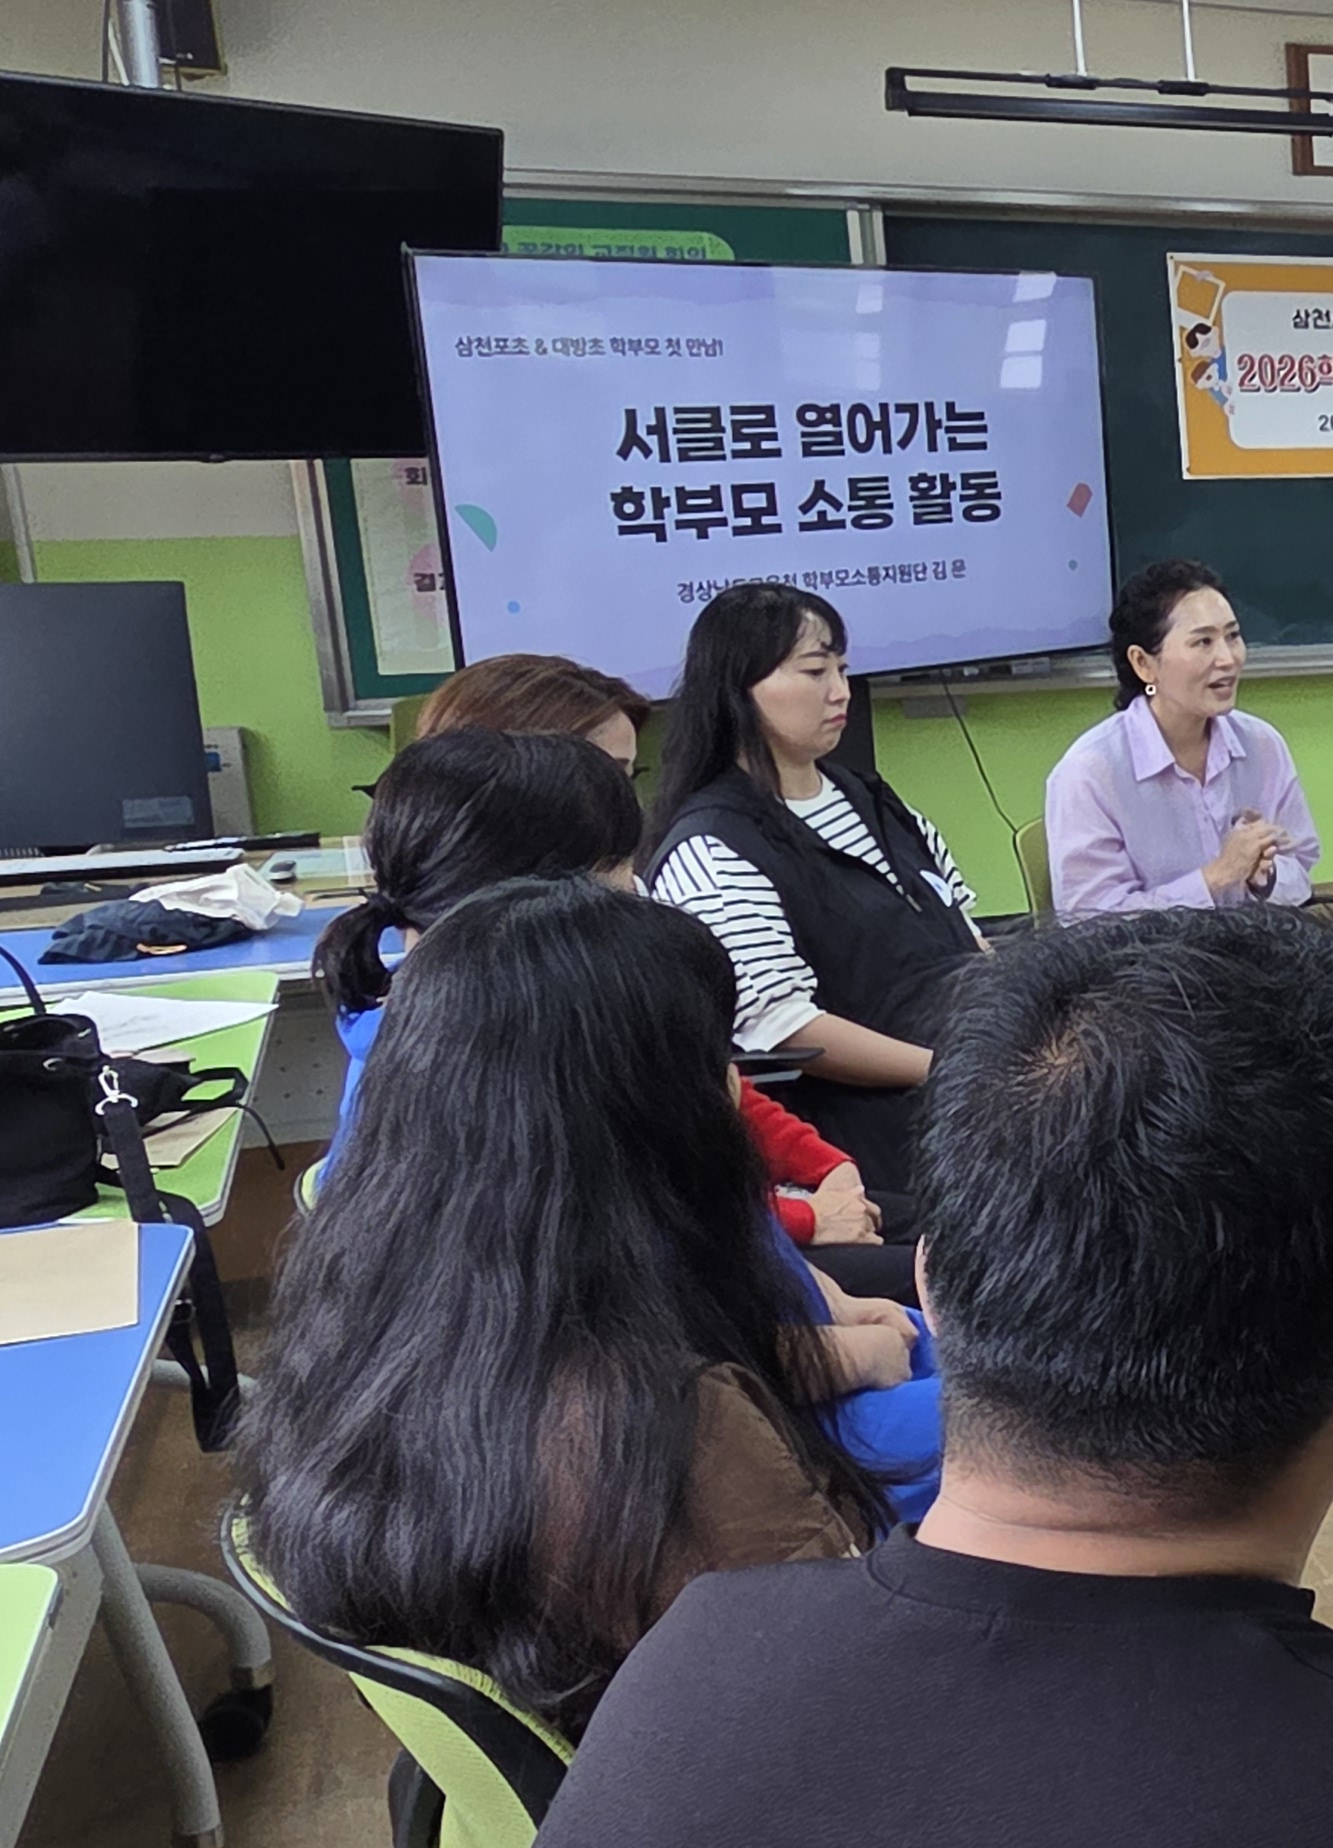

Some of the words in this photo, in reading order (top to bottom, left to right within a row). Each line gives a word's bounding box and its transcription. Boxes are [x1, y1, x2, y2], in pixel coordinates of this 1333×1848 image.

[455, 336, 531, 358] 삼천포초
[535, 339, 548, 357] &
[552, 338, 606, 358] 대방초
[609, 338, 662, 358] 학부모
[666, 338, 682, 358] 첫
[616, 404, 782, 464] 서클로
[796, 402, 989, 459] 열어가는
[610, 482, 784, 544] 학부모
[798, 476, 895, 533] 소통
[909, 471, 1003, 527] 활동
[802, 562, 928, 590] 학부모소통지원단
[933, 560, 948, 581] 김
